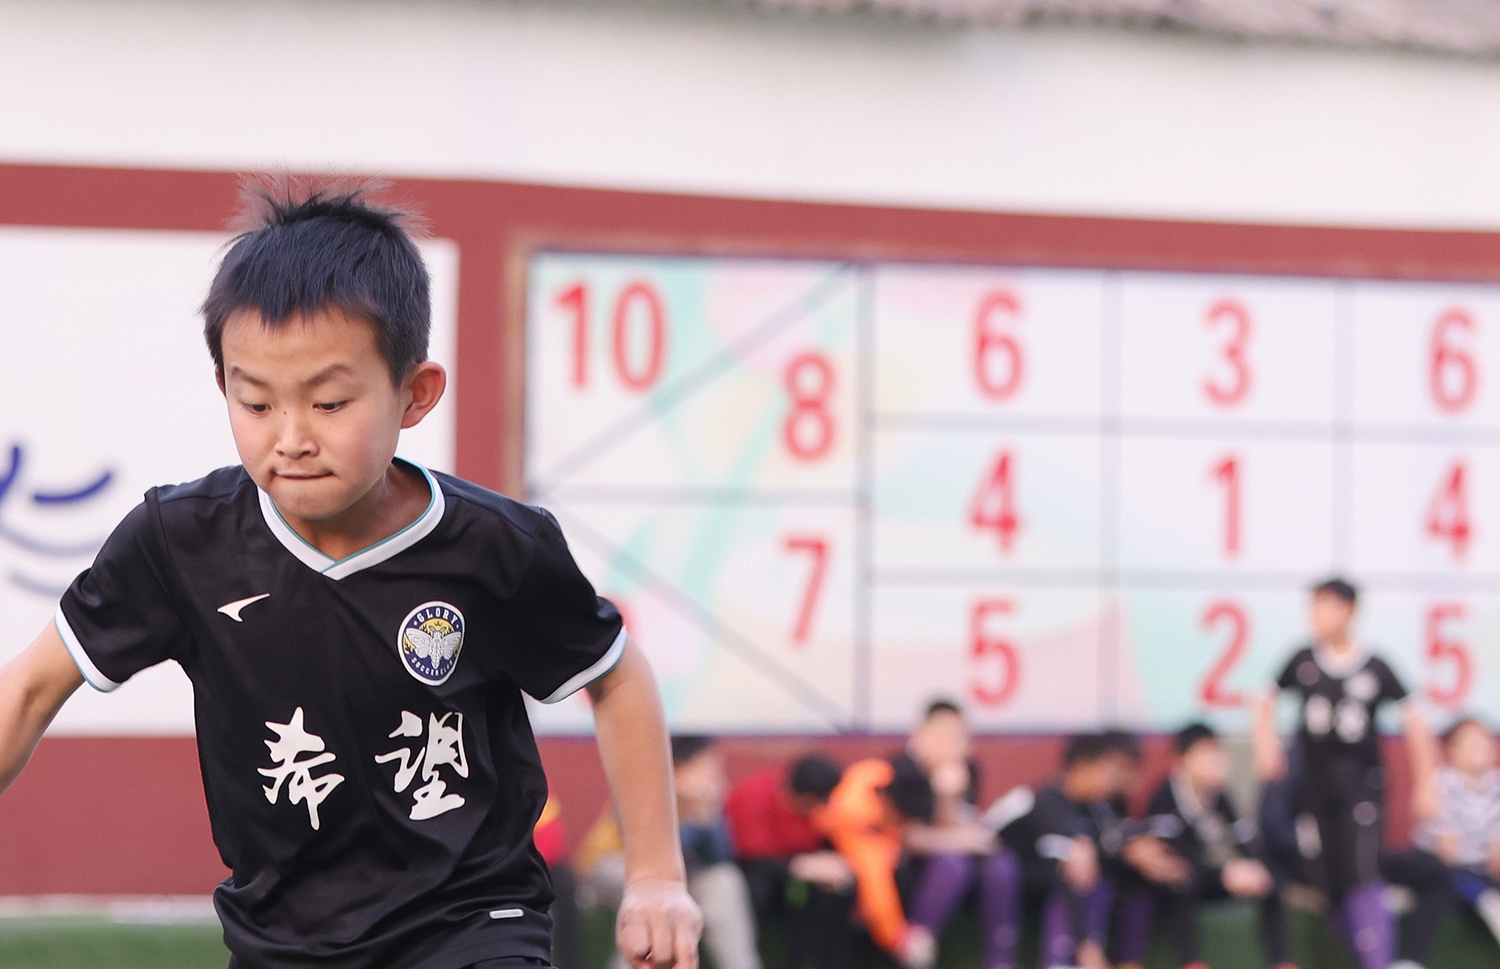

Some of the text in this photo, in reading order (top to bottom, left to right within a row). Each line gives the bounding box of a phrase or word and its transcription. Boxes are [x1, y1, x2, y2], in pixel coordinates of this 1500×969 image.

[552, 279, 667, 394] 10
[973, 290, 1024, 399] 6
[1204, 298, 1253, 408] 3
[1429, 309, 1479, 414] 6
[782, 352, 836, 461] 8
[967, 449, 1024, 553] 4
[1207, 453, 1244, 558] 1
[1425, 461, 1477, 559] 4
[416, 607, 458, 625] GLORY
[780, 533, 833, 647] 7
[969, 599, 1021, 708] 5
[1197, 599, 1253, 709] 2
[1425, 605, 1475, 709] 5
